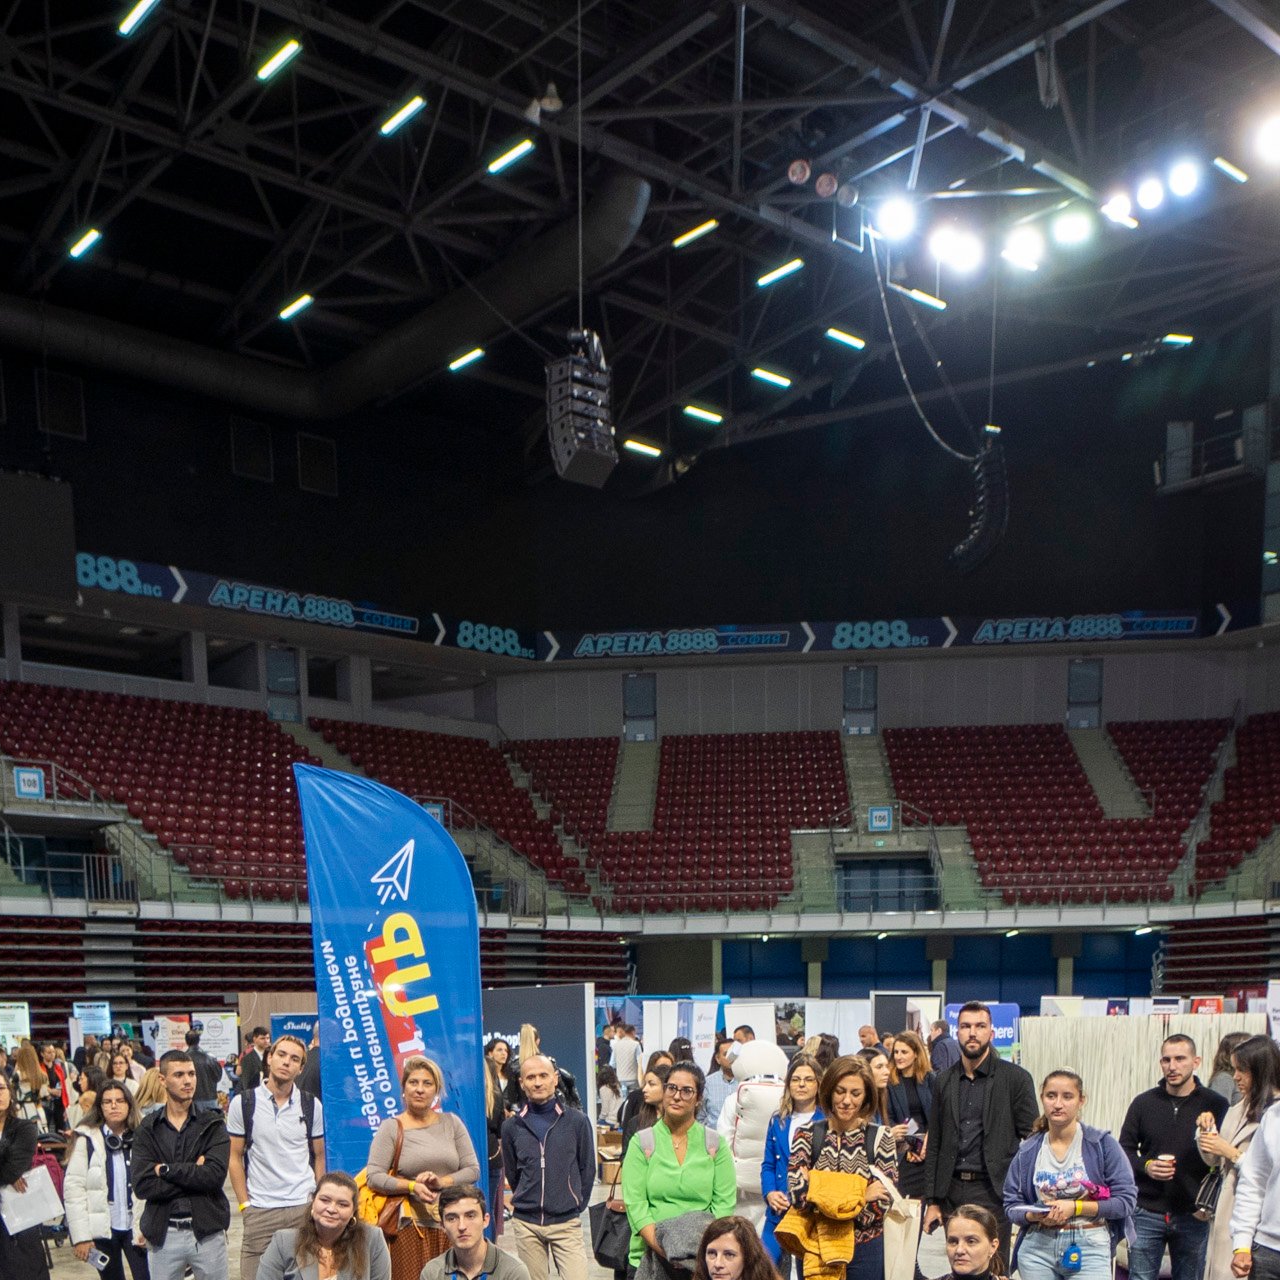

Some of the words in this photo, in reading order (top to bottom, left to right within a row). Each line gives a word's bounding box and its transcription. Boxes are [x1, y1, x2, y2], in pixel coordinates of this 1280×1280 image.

[75, 551, 162, 598] 888.BG
[211, 582, 301, 616] АРЕНА
[303, 596, 355, 622] 8888
[975, 620, 1065, 642] АРЕНА
[1068, 616, 1123, 638] 8888
[575, 635, 664, 656] АРЕНА
[665, 630, 719, 652] 8888
[283, 1021, 312, 1031] Shelly
